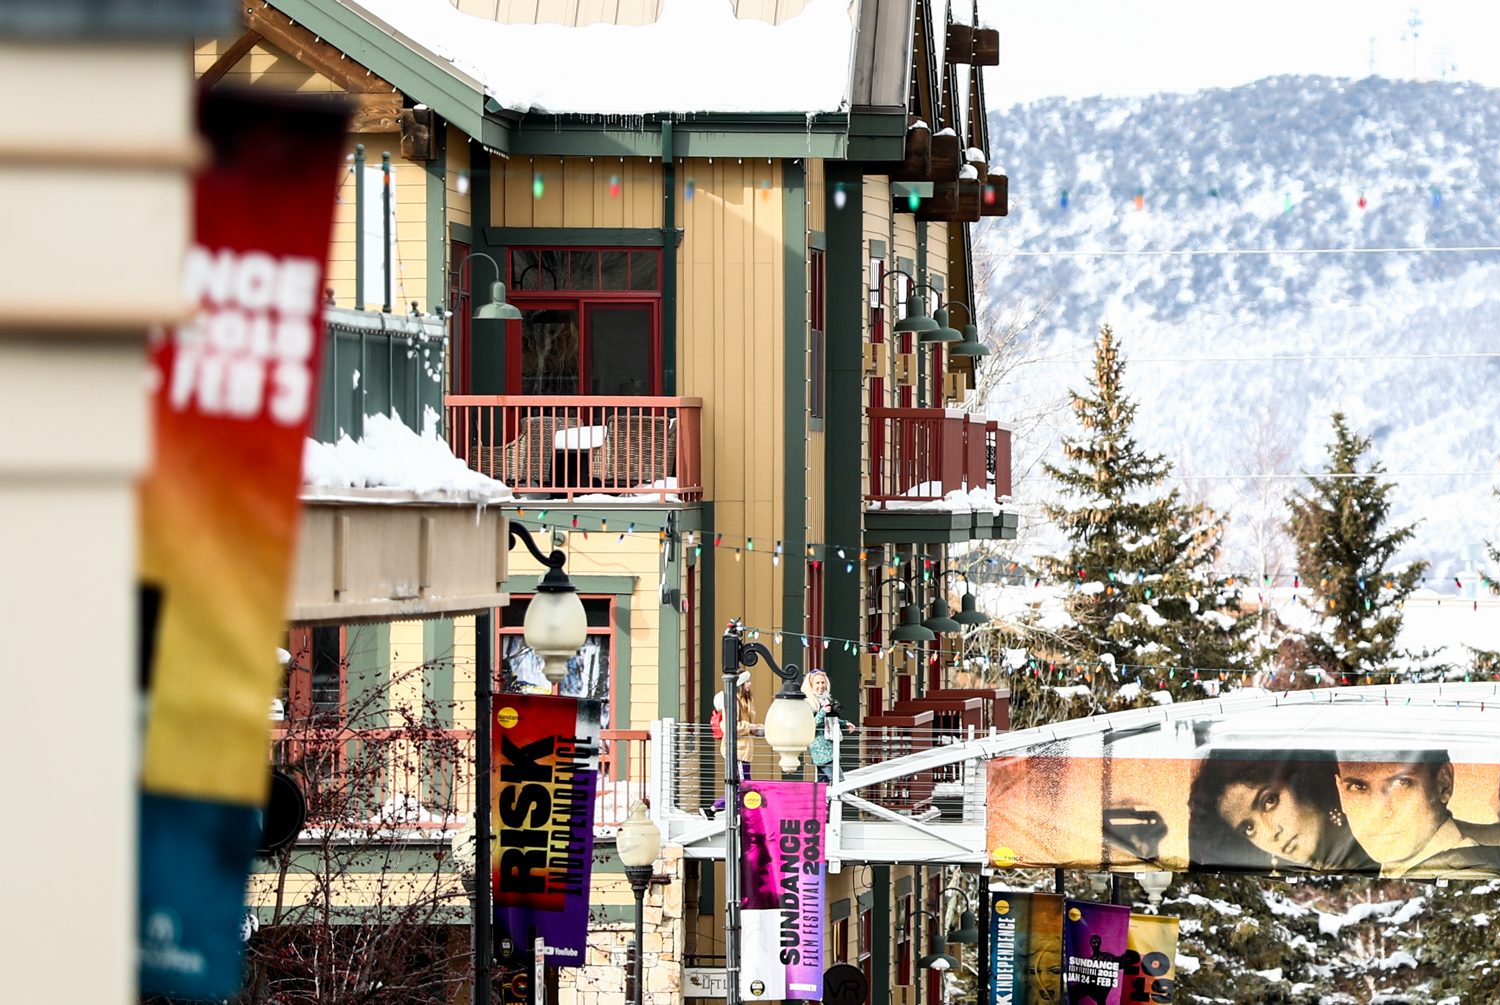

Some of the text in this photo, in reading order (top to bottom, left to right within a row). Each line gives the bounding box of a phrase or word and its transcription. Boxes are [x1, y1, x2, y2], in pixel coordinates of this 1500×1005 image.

[499, 735, 556, 894] RISK
[547, 734, 592, 897] INDEPENDENCE
[803, 818, 821, 876] 2019
[780, 819, 801, 966] SUNDANCE
[802, 881, 820, 934] FESTIVAL
[554, 947, 578, 957] YouTube
[803, 939, 820, 967] FILM
[996, 917, 1016, 993] INDEPENDENCE
[1069, 956, 1119, 971] SUNDANCE
[825, 978, 860, 999] VR
[1068, 973, 1080, 982] JAN
[1081, 974, 1090, 984] 24
[1096, 976, 1111, 987] FEB
[1112, 979, 1118, 988] 3
[1097, 970, 1119, 978] 2019
